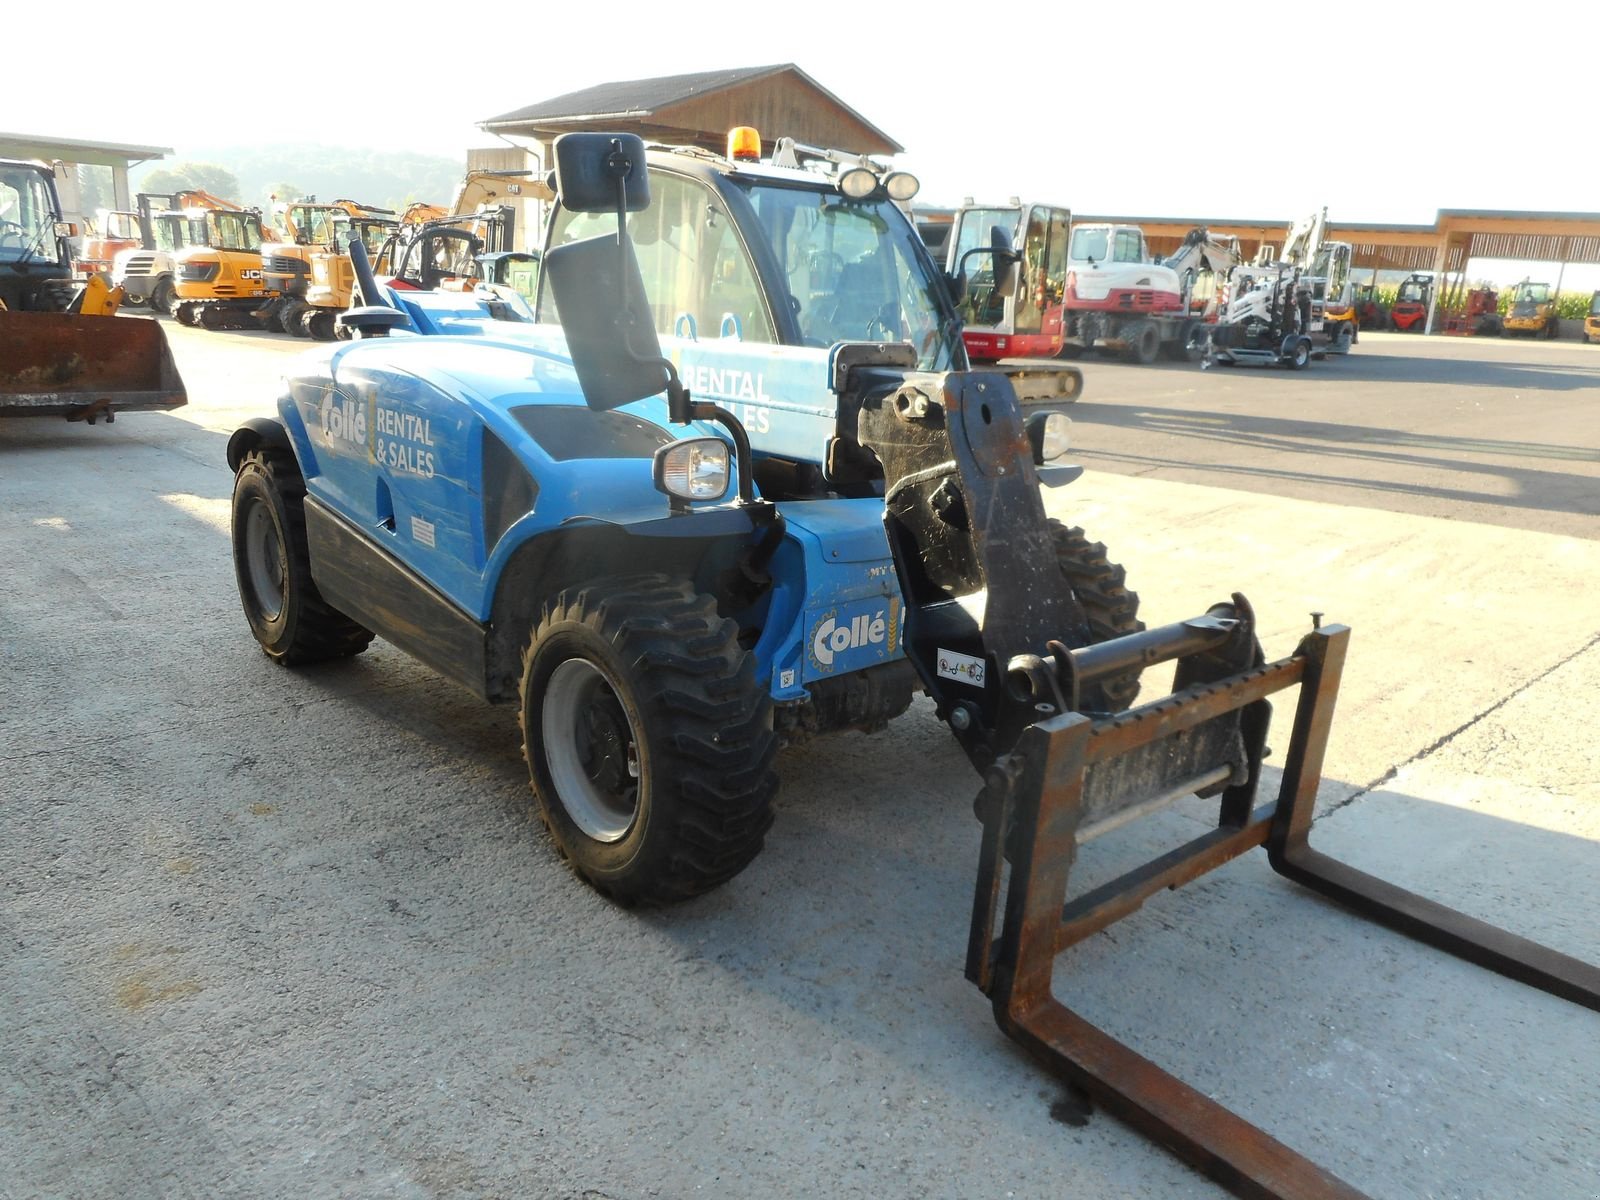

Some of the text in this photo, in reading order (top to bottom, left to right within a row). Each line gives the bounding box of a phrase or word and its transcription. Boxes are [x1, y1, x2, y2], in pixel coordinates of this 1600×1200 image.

[507, 184, 519, 193] CAT
[683, 365, 770, 402] RENTAL
[321, 391, 366, 448] Collé
[377, 407, 434, 447] RENTAL
[376, 438, 434, 479] & SALES
[814, 610, 885, 665] Collé
